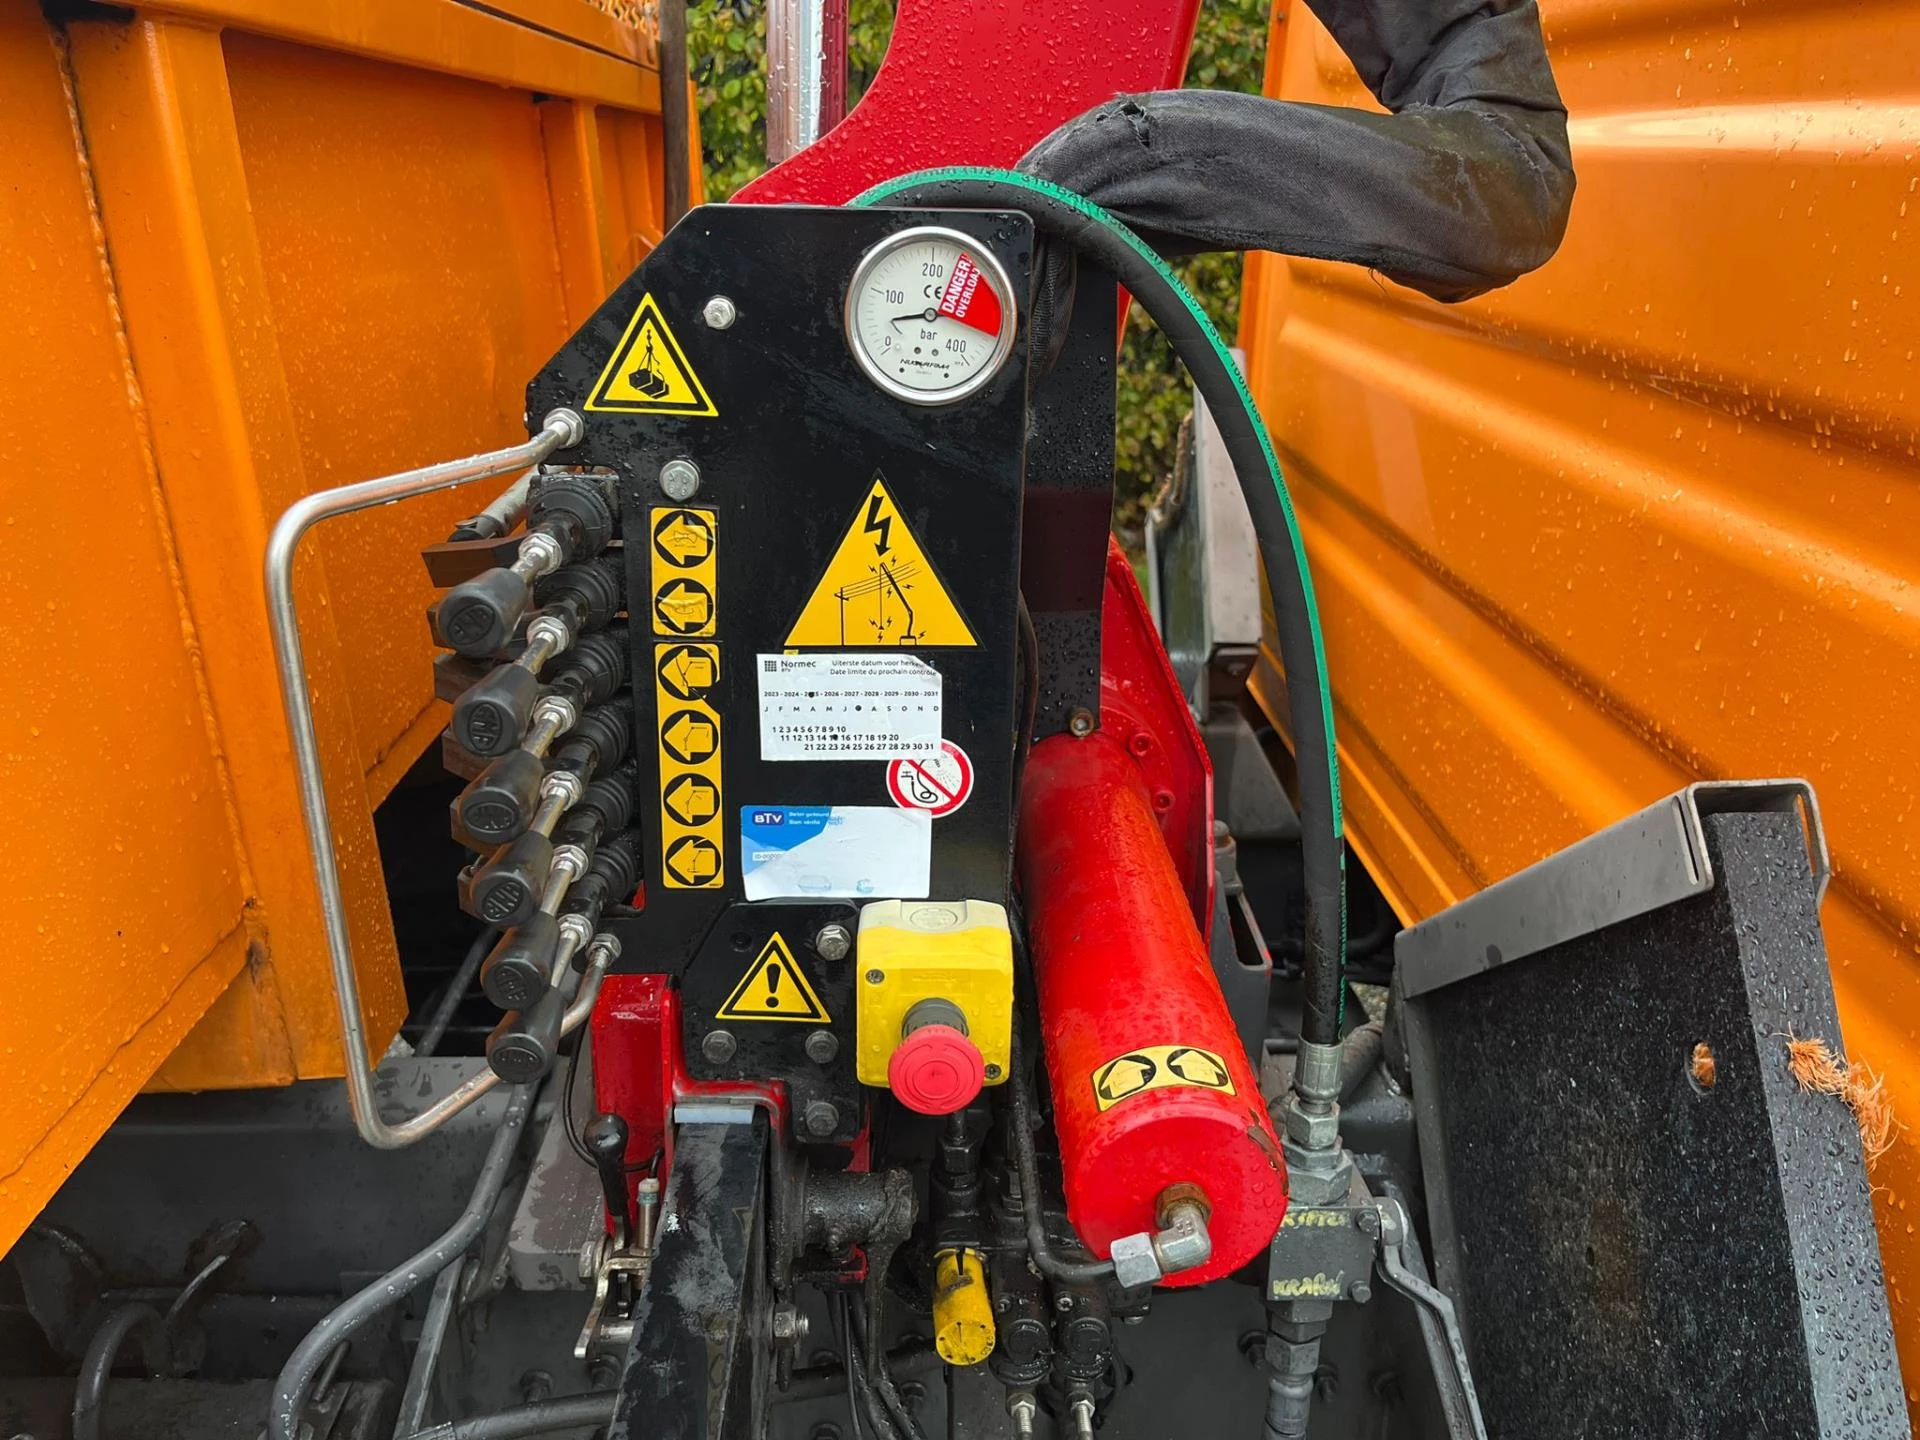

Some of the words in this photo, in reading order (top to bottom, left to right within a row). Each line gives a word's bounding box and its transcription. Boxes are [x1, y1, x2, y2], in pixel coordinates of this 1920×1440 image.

[922, 263, 943, 278] 200
[886, 289, 904, 304] 100
[920, 328, 938, 341] bar
[884, 336, 891, 347] 0
[945, 338, 967, 353] 400
[781, 660, 816, 669] Normec
[755, 813, 782, 824] BTV
